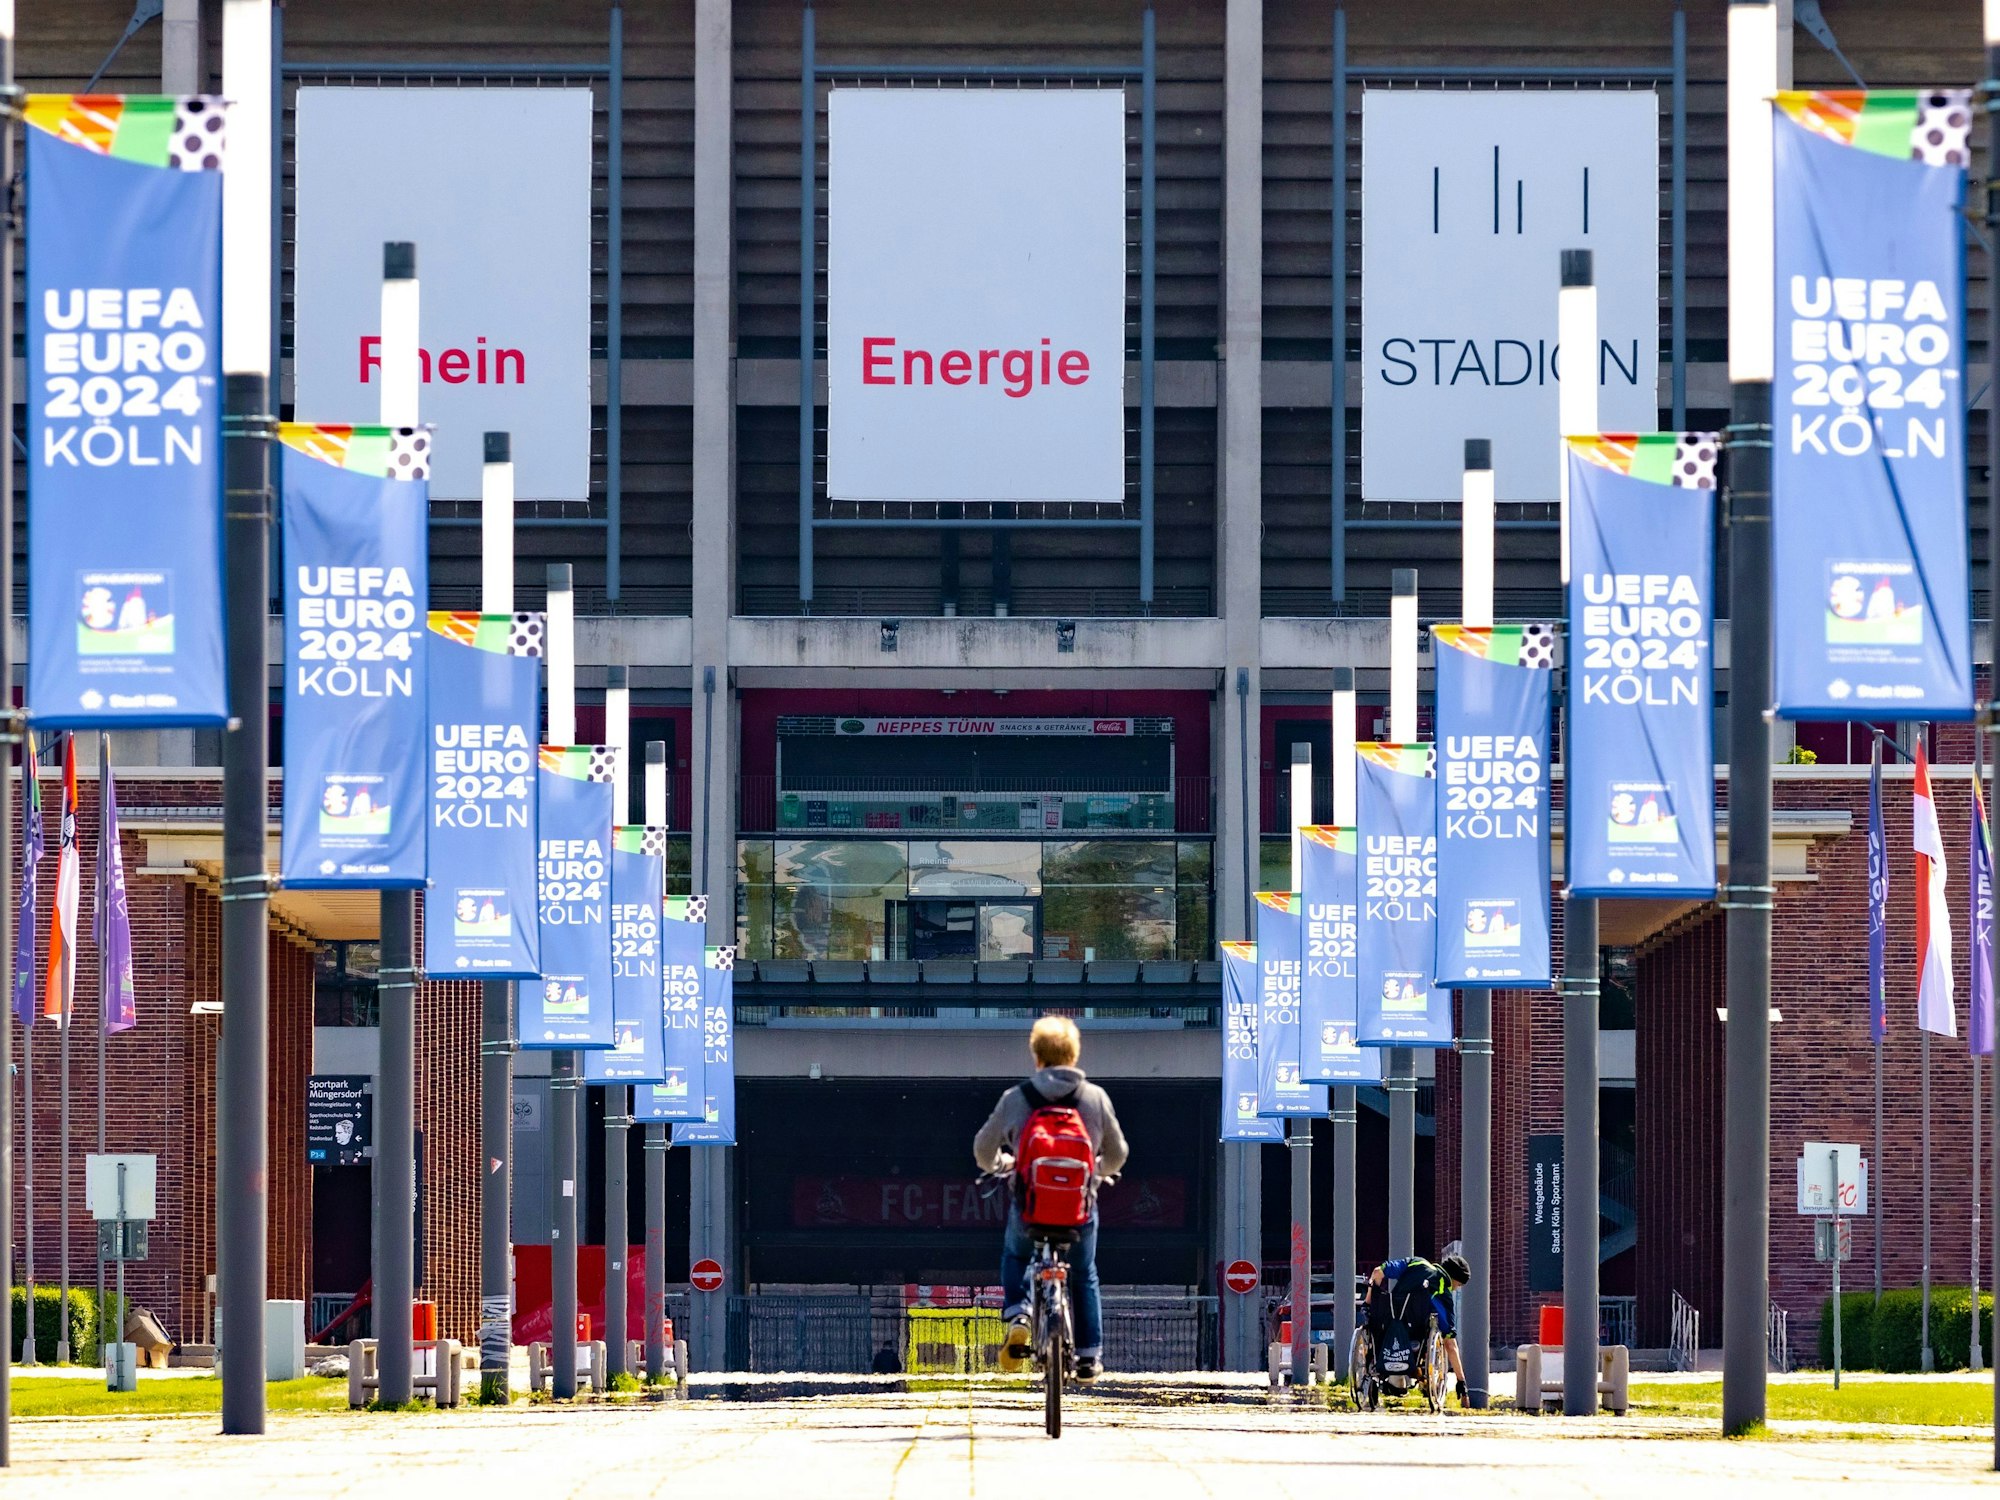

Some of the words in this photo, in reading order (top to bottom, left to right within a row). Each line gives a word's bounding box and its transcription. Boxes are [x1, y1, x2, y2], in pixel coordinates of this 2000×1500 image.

[44, 287, 204, 330] UEFA
[1791, 275, 1948, 321] UEFA
[44, 331, 206, 373] EURO
[1792, 319, 1950, 367] EURO
[359, 336, 525, 384] Rein
[863, 337, 1090, 398] Energie
[1381, 337, 1638, 386] STADIN
[44, 417, 202, 466] KÖLN
[298, 566, 414, 596] UEFA
[1583, 574, 1700, 605] UEFA
[298, 598, 415, 629] EURO
[1583, 605, 1702, 638] EURO
[298, 661, 412, 697] KÖLN
[1583, 668, 1699, 705] KÖLN
[435, 724, 528, 748] UEFA
[877, 721, 943, 733] NEPPES
[948, 718, 995, 733] TÜNN
[1043, 723, 1087, 731] GETRÄNKE
[1446, 735, 1539, 759] UEFA
[435, 750, 530, 774] EURO
[1446, 761, 1540, 785] EURO
[435, 799, 527, 828] KÖLN
[1446, 810, 1537, 838] KÖLN
[1366, 835, 1436, 856] UEFA
[1366, 856, 1436, 877] EURO
[1308, 903, 1356, 921] UEF
[1366, 897, 1436, 921] KÖLN
[1308, 922, 1357, 939] EUR
[1308, 940, 1356, 957] 202
[1308, 957, 1356, 977] KÖL
[309, 1080, 349, 1090] Sportpark
[309, 1090, 362, 1100] Müngersdorf
[1535, 1162, 1545, 1225] Westgebäude
[1552, 1163, 1562, 1204] Sportamt
[881, 1184, 1005, 1220] FC-FAN
[1552, 1205, 1561, 1227] Köln
[1552, 1228, 1561, 1253] Stadt
